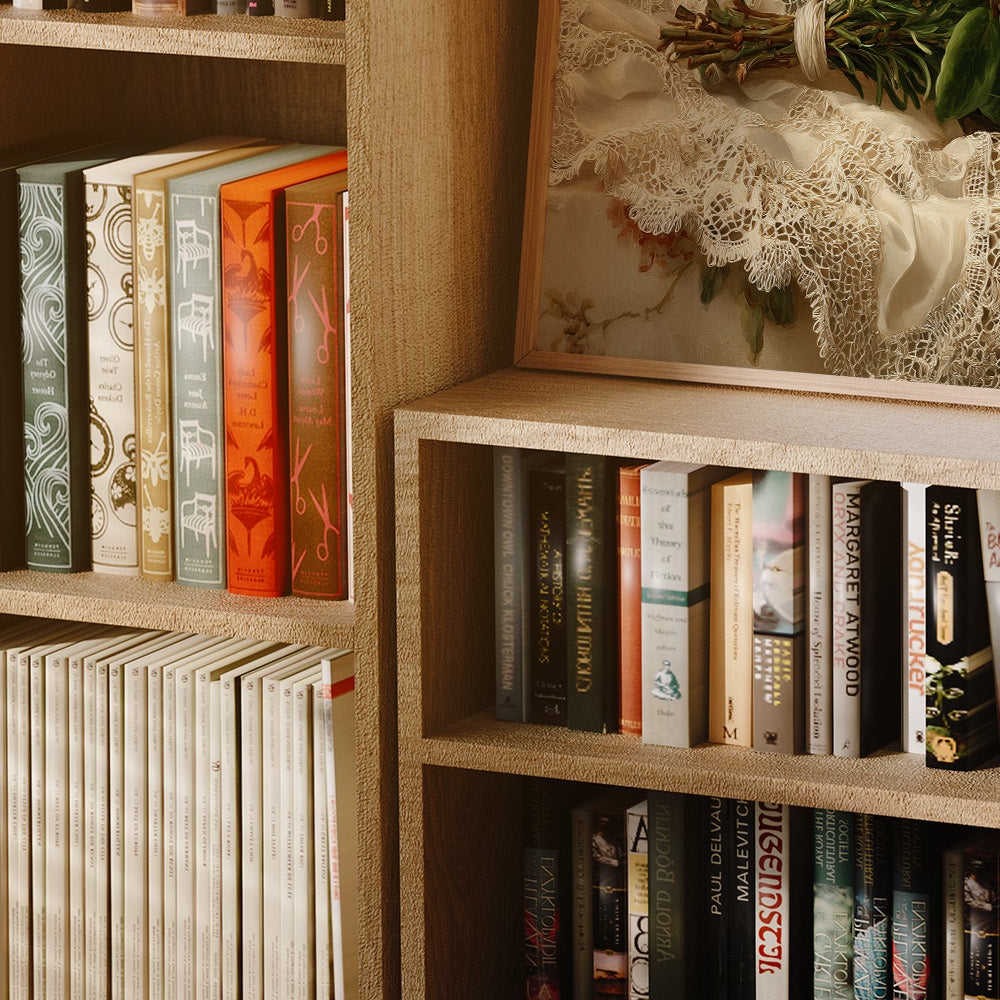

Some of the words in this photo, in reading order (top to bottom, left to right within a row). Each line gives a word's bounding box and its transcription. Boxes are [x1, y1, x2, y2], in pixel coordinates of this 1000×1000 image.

[833, 492, 845, 544] ORYX
[845, 492, 859, 606] MARGARET
[833, 601, 845, 669] CRAKE
[845, 611, 860, 697] ATWOOD
[710, 870, 722, 915] PAUL
